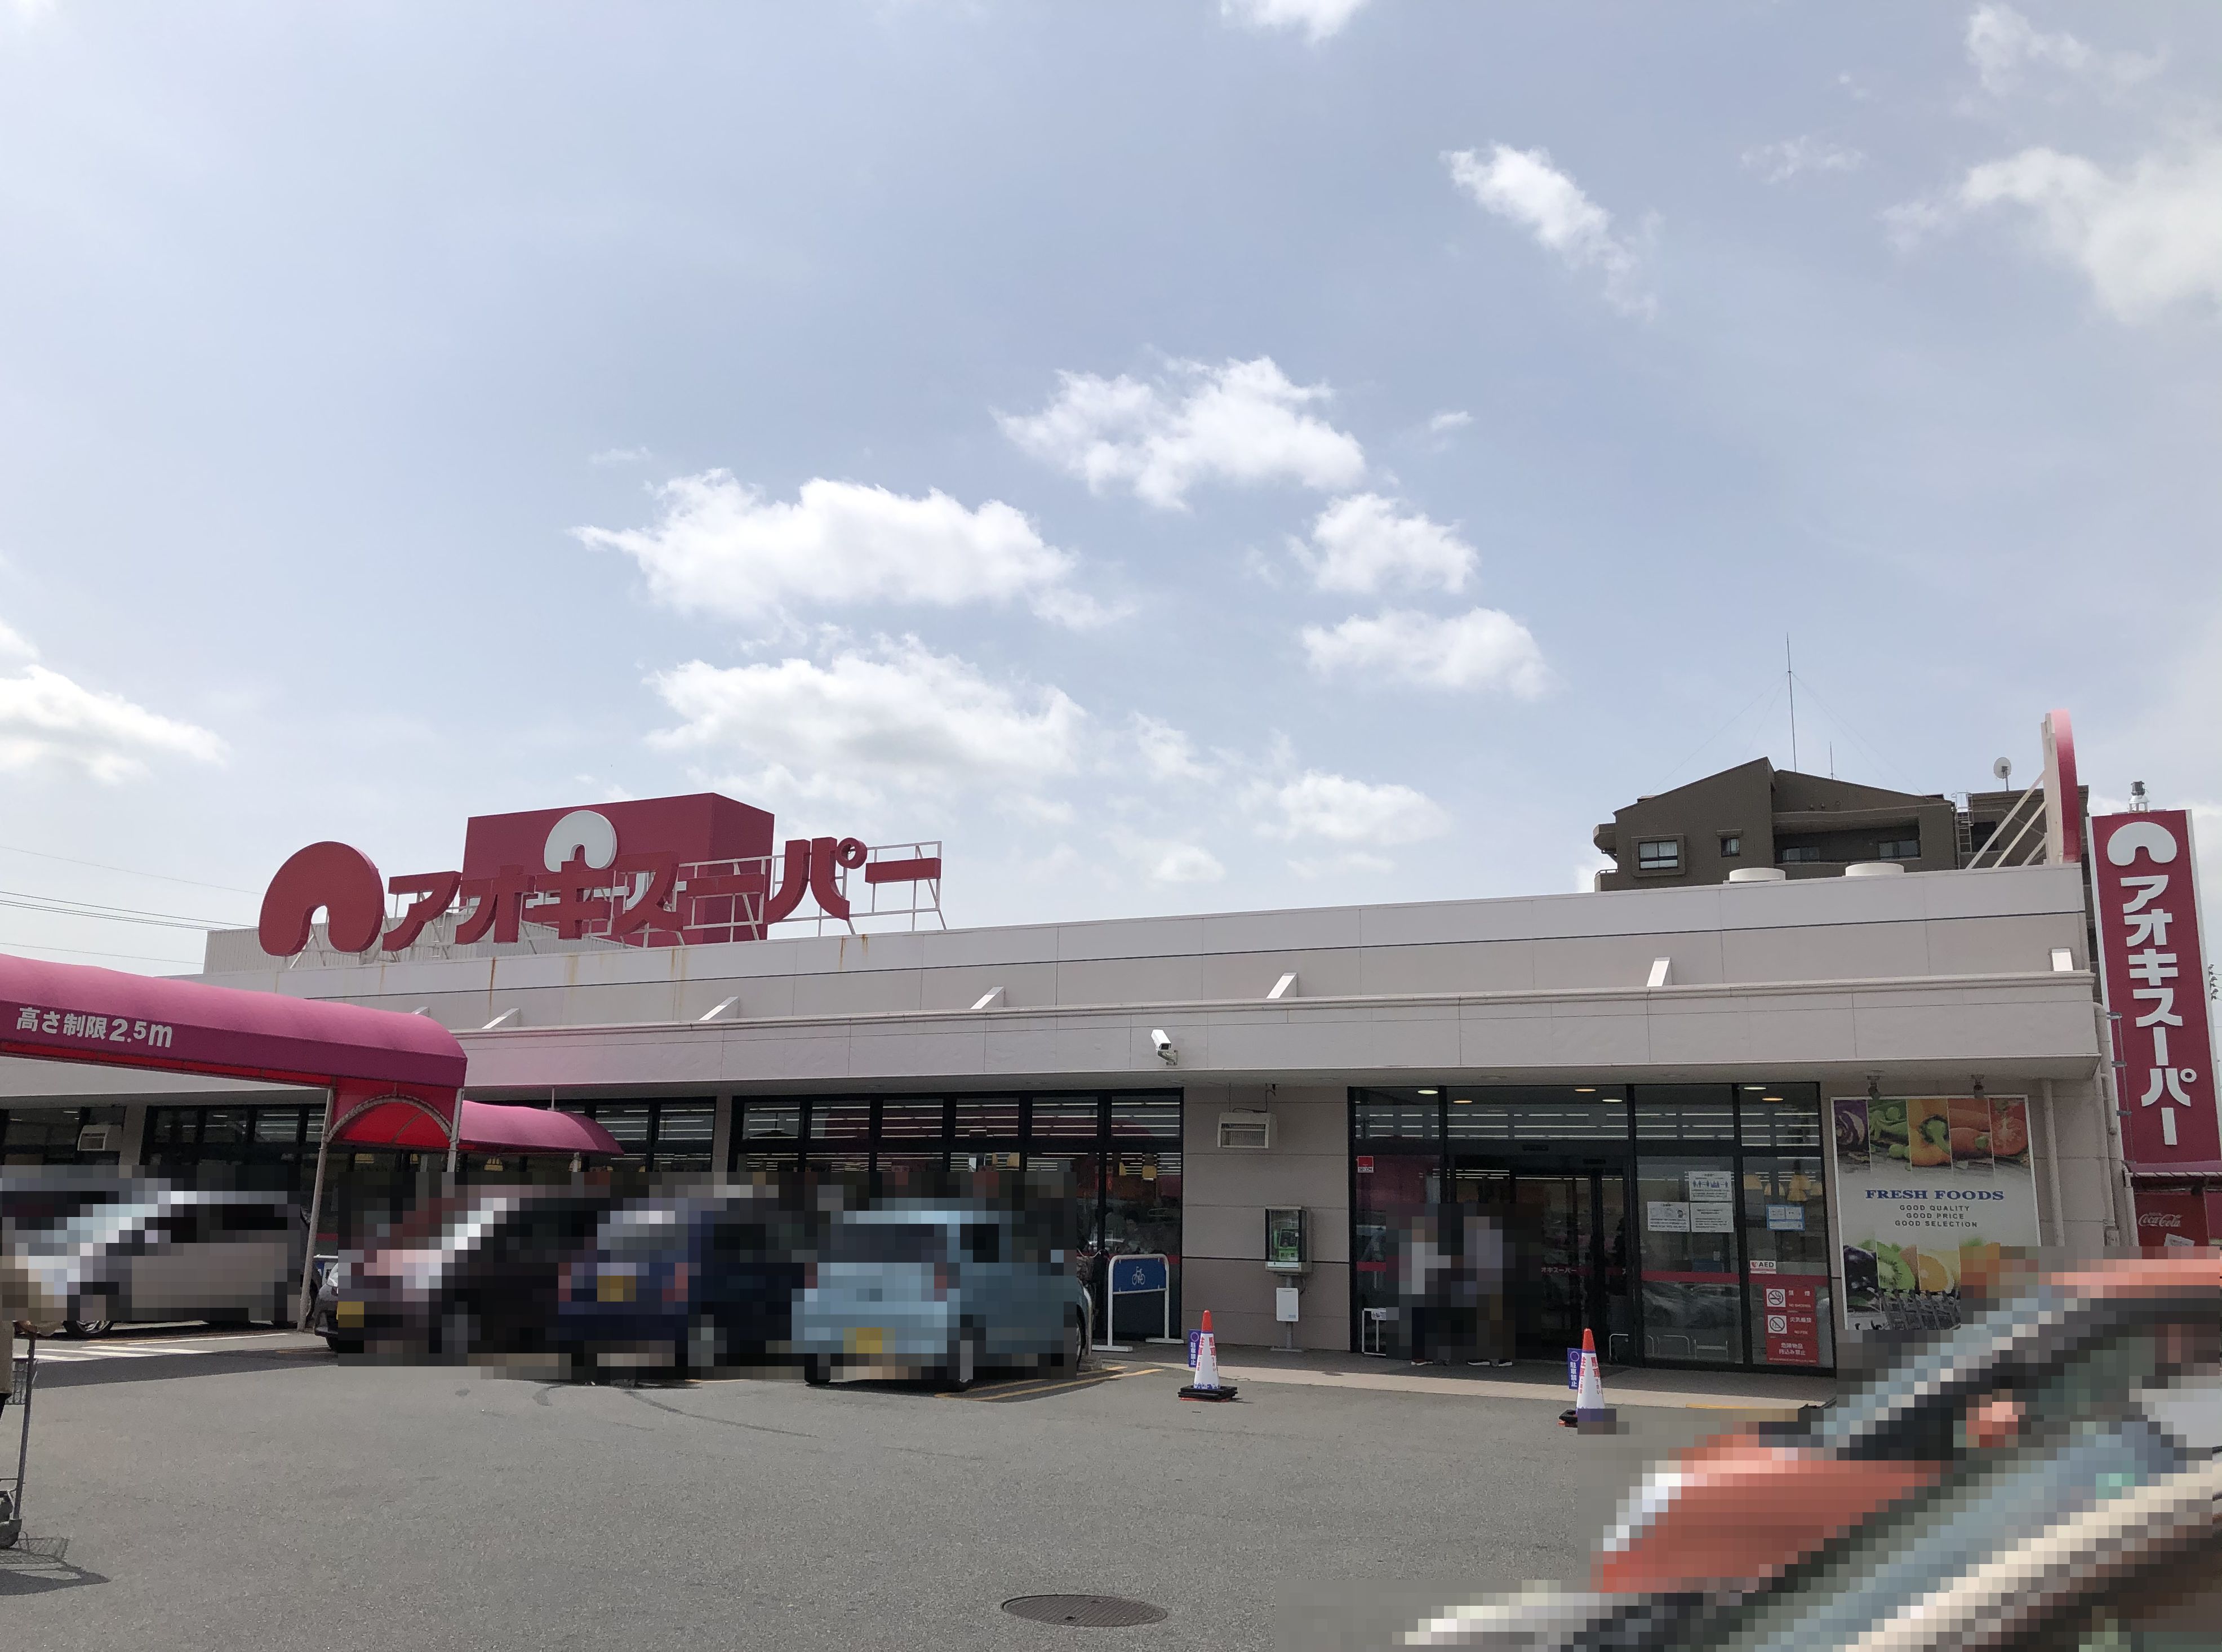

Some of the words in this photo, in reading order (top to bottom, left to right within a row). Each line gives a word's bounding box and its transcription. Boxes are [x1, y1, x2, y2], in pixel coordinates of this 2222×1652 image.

[382, 836, 941, 952] アオキスーパー
[16, 1007, 172, 1048] 高さ制限2.5m
[2119, 874, 2197, 1145] アオキスーパー
[1865, 1189, 1928, 1200] FRESH
[1934, 1190, 2005, 1201] FOODS
